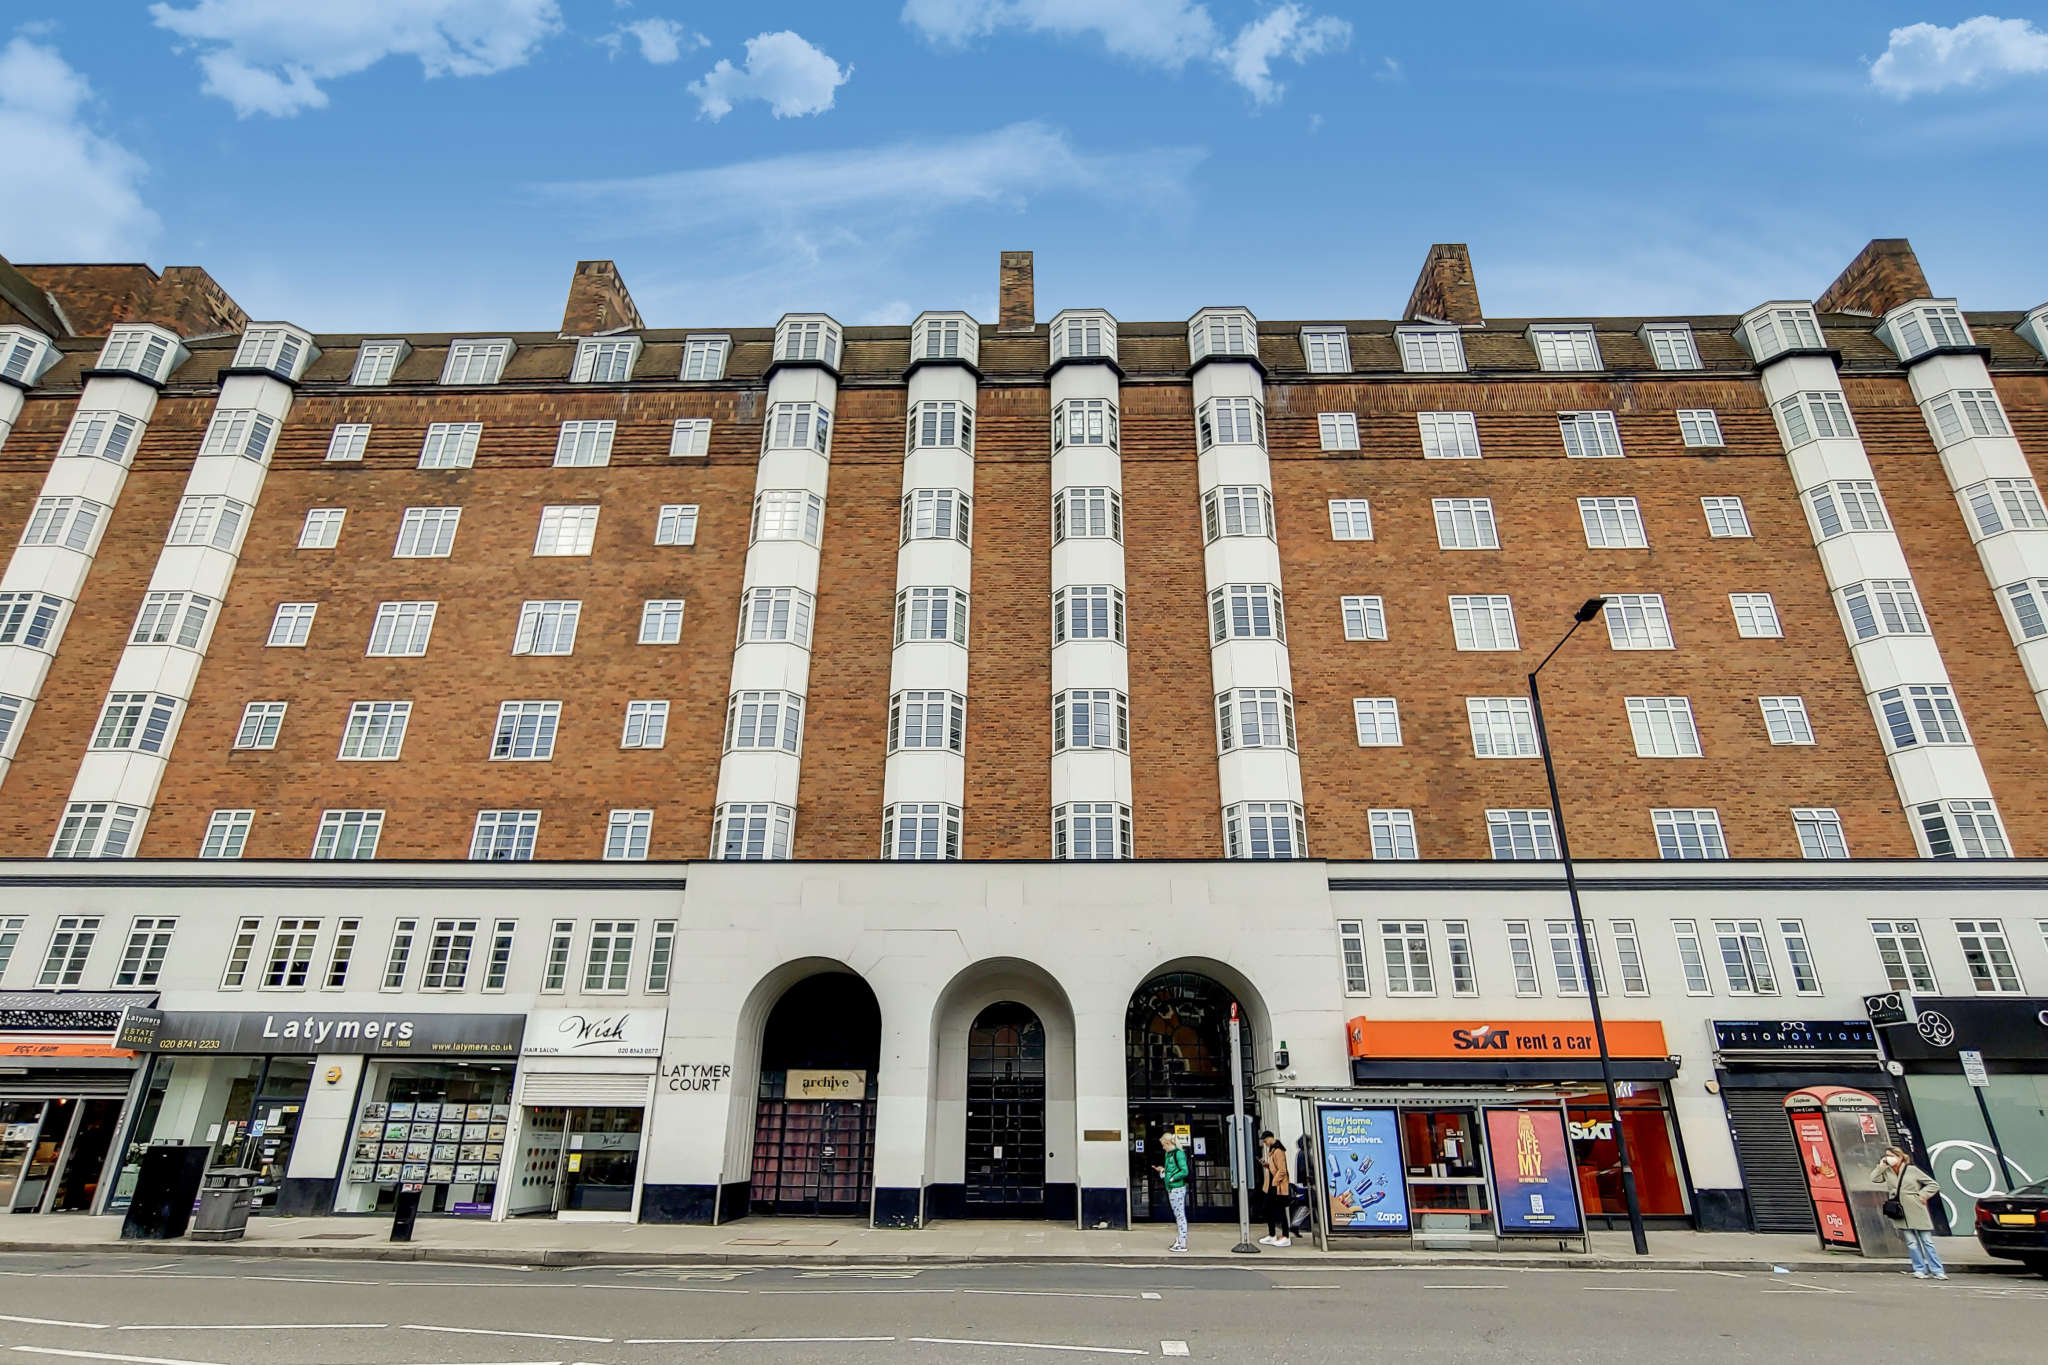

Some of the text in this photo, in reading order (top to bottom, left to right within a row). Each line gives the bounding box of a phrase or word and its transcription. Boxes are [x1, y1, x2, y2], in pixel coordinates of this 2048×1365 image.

[126, 1014, 161, 1026] Latymers
[124, 1027, 155, 1037] ESTATE
[263, 1015, 414, 1044] Latymers
[559, 1013, 631, 1040] Wish
[122, 1035, 153, 1044] AGENTS
[1453, 1025, 1591, 1050] SIXT rent a car
[160, 1040, 220, 1048] 020 8741 2233
[432, 1042, 513, 1052] www.latymers.co.uk
[661, 1065, 731, 1077] LATYMER
[669, 1079, 721, 1091] COURT
[802, 1075, 849, 1090] archive
[1326, 1116, 1373, 1126] Stay Home,
[1327, 1126, 1368, 1136] Stay Safe,
[1569, 1119, 1613, 1139] SIXT
[1328, 1136, 1383, 1145] Zapp Delivers.
[1517, 1139, 1541, 1155] LIFE
[1518, 1154, 1541, 1176] MY
[1377, 1212, 1403, 1223] Zapp
